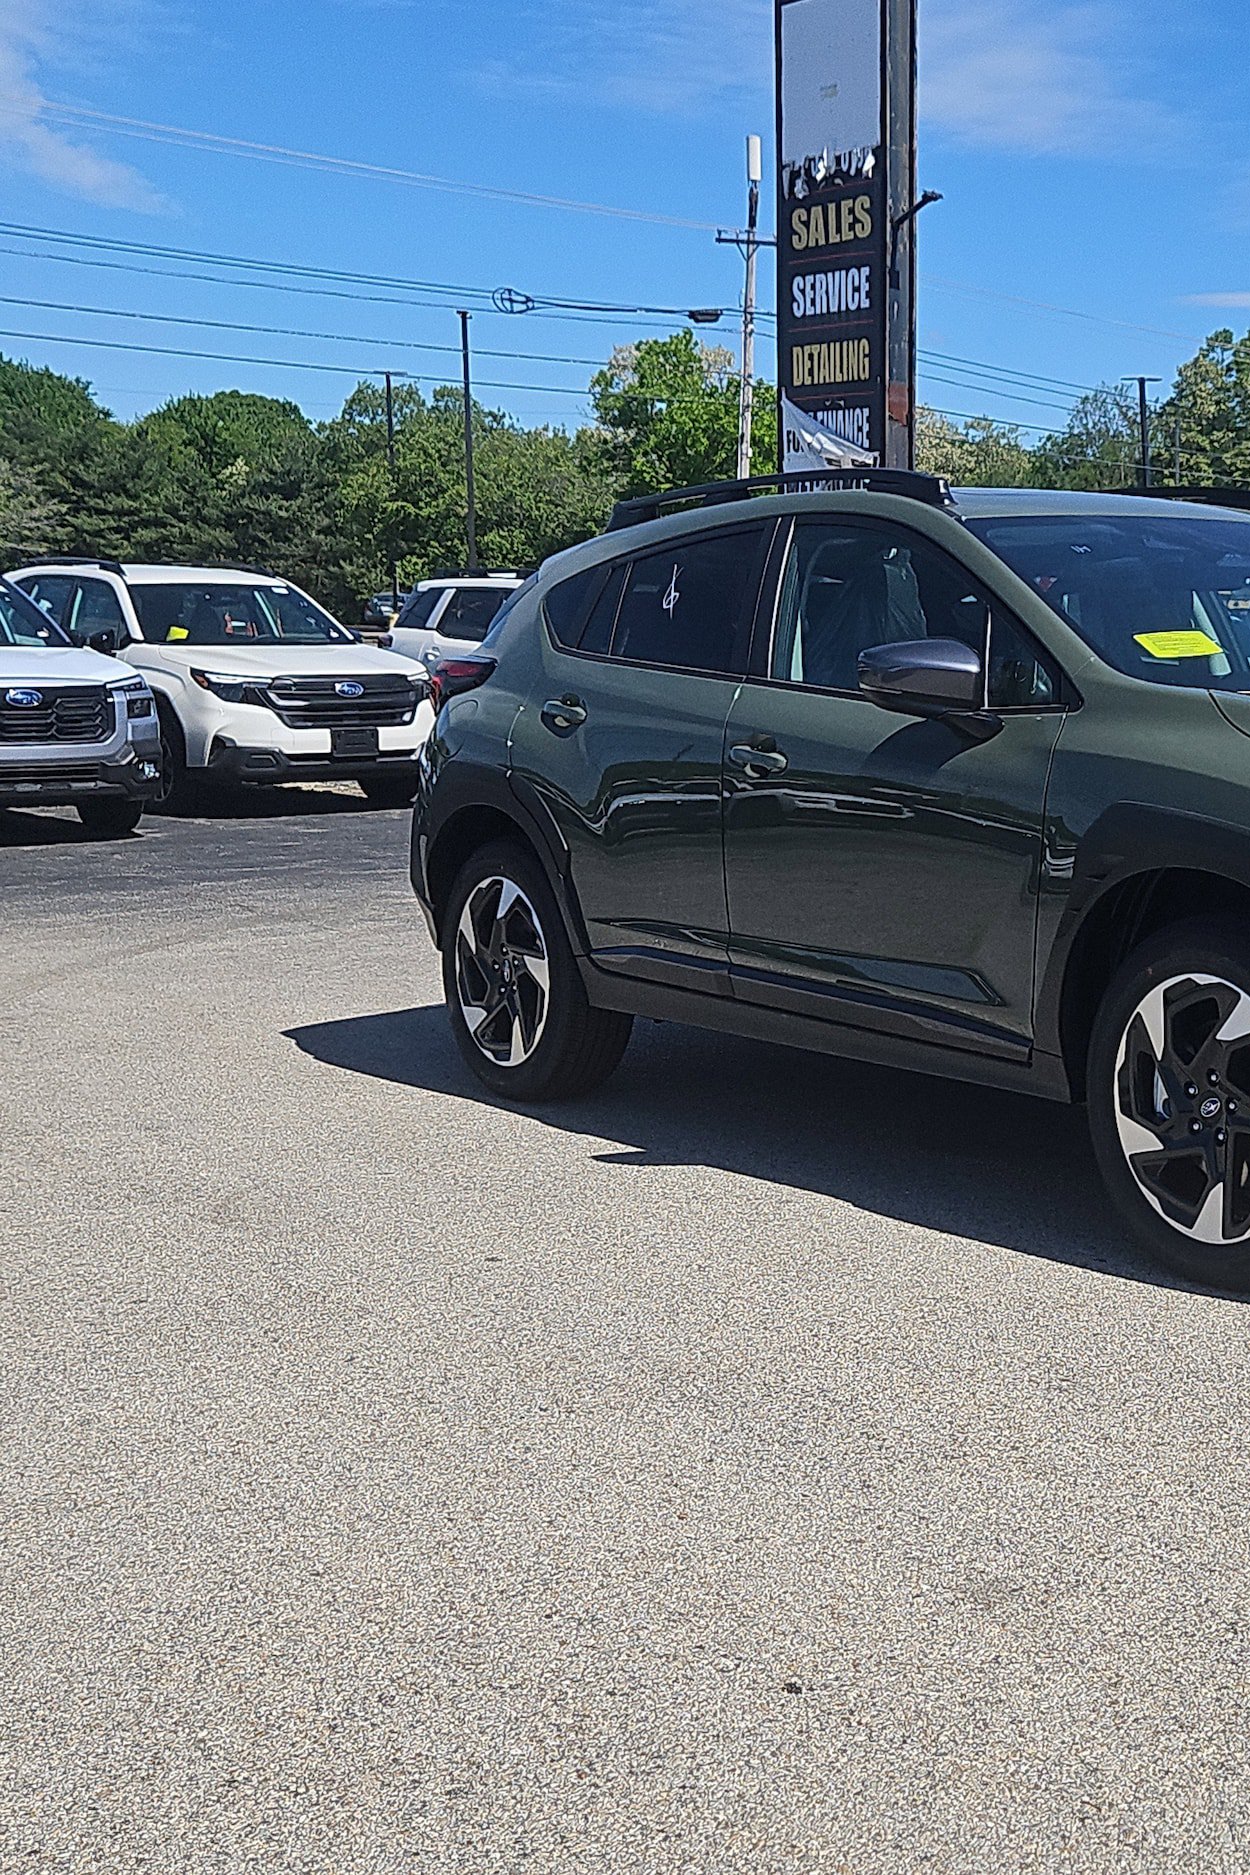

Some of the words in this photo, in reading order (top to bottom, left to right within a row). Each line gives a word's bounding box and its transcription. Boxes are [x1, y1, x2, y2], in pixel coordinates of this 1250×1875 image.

[791, 195, 872, 250] SALES
[792, 266, 870, 319] SERVICE
[792, 337, 870, 386] DETAILING
[816, 407, 870, 448] NANCE
